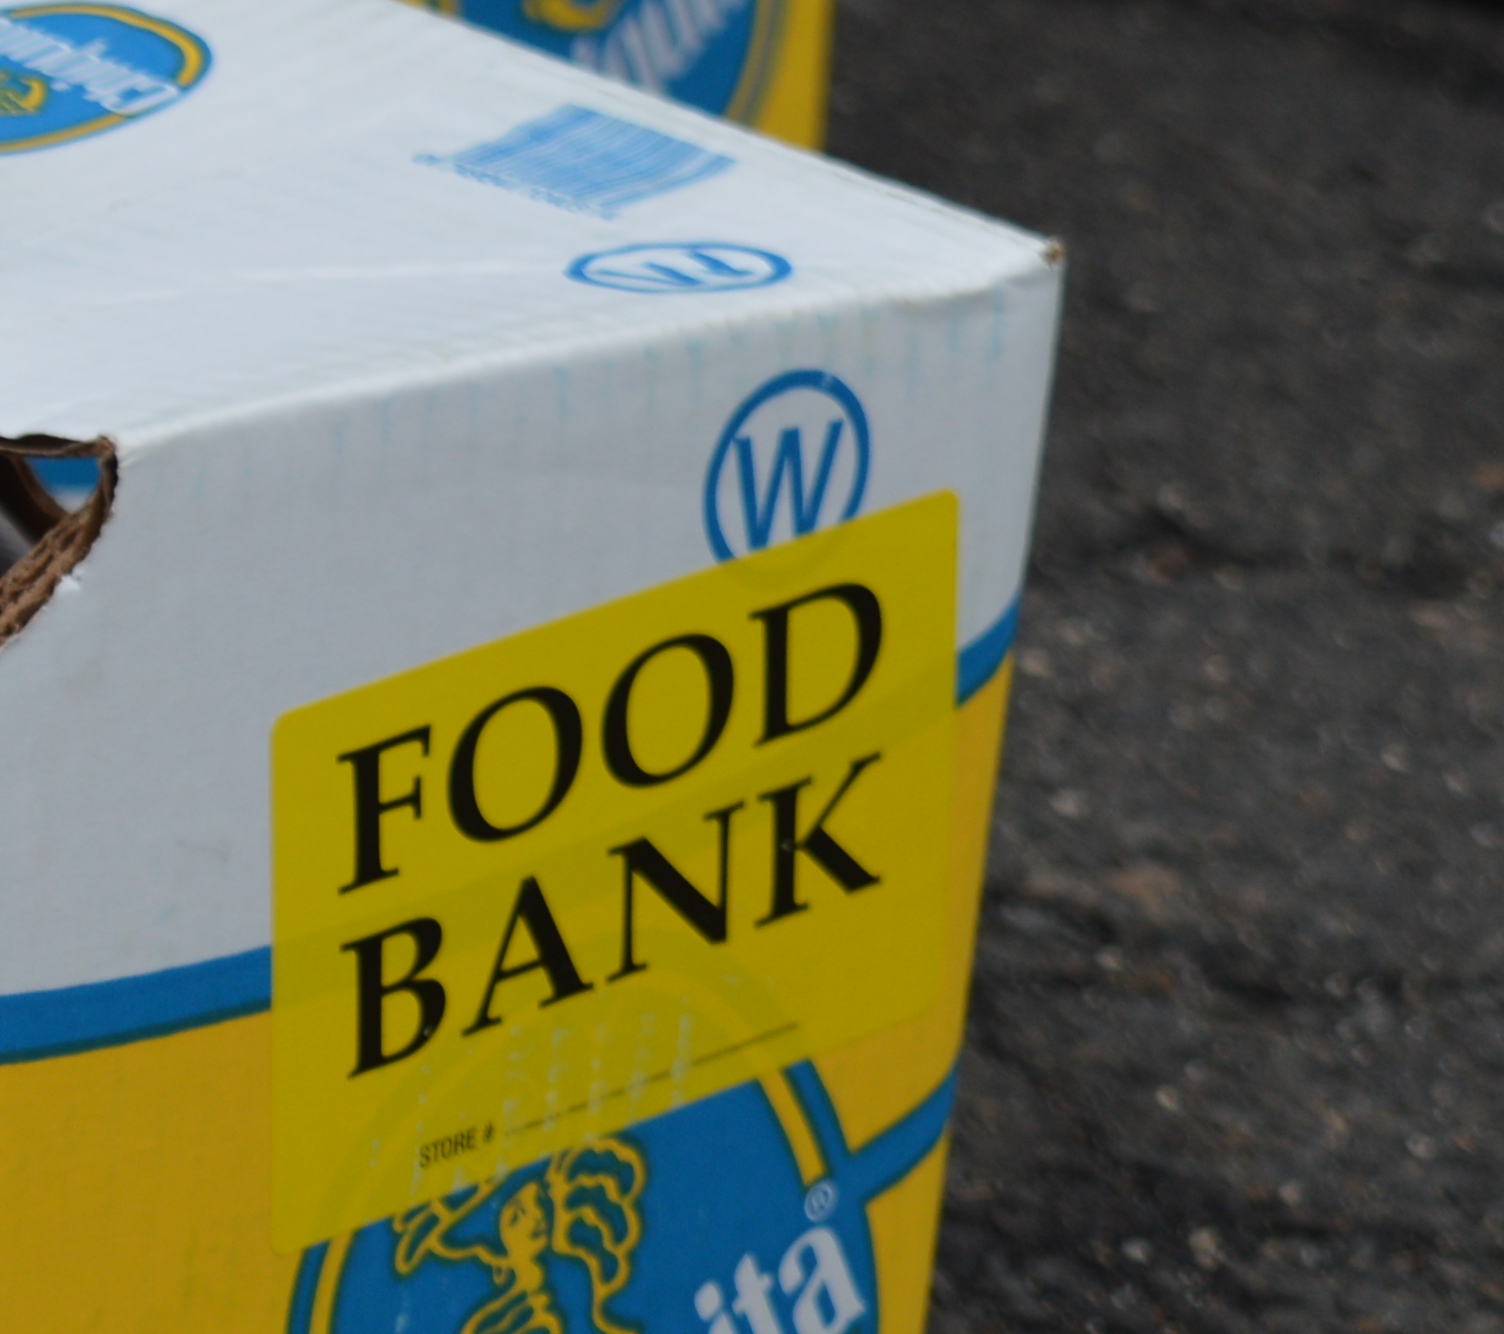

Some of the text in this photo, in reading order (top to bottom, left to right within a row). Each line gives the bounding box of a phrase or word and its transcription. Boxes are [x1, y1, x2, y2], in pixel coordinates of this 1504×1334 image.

[726, 405, 844, 564] W
[336, 581, 884, 895] FOOD
[338, 751, 883, 1079] BANK
[418, 1128, 477, 1171] STORE
